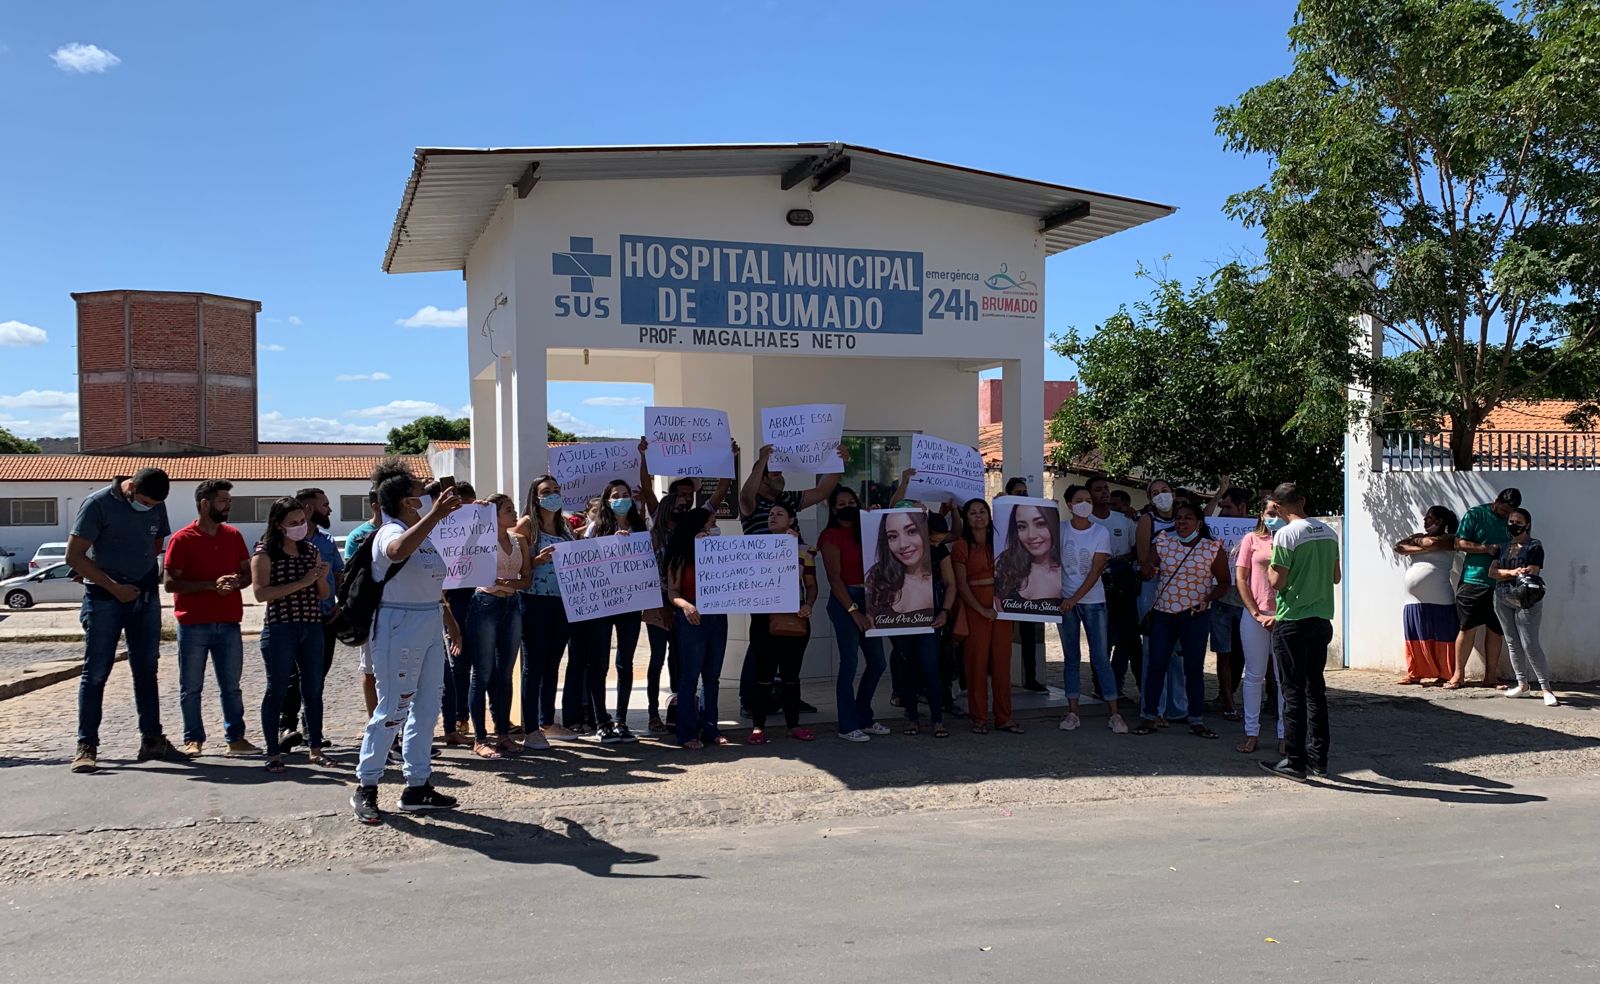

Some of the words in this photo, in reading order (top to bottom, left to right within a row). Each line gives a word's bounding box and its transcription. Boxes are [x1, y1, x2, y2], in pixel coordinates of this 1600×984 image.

[624, 241, 776, 285] HOSPITAL
[783, 251, 920, 291] MUNICIPAL
[925, 269, 979, 282] emergência
[554, 295, 610, 319] SUS
[658, 287, 697, 324] DE
[727, 290, 883, 330] BRUMADO
[927, 287, 979, 321] 24h
[982, 296, 1038, 313] BRUMADO
[639, 327, 683, 344] PROF.
[692, 329, 800, 348] MAGALHAES
[812, 333, 856, 350] NETO
[653, 415, 711, 427] AJUDE-NOS
[716, 418, 724, 427] A
[768, 414, 806, 429] ABRACE
[810, 412, 833, 424] ESSA
[653, 430, 686, 443] SALVAR
[692, 431, 713, 442] ESSA
[556, 445, 629, 466] AJUDE-NOS
[917, 451, 944, 461] SALVAR
[946, 455, 963, 466] ESSA
[965, 450, 972, 458] A
[566, 460, 607, 478] SALVAR
[613, 458, 639, 472] ESSA
[472, 509, 481, 520] A
[440, 526, 466, 539] ESSA
[469, 522, 496, 535] VIDA
[702, 538, 767, 553] PRECISAMOS
[774, 538, 789, 549] DE
[562, 549, 602, 567] ACORDA
[698, 555, 714, 565] UM
[559, 566, 605, 585] ESTAMOS
[697, 566, 756, 582] PRECISAMOS
[760, 566, 772, 575] DE
[777, 564, 797, 574] UMA
[565, 582, 587, 594] UMA
[590, 577, 611, 589] VIDA
[589, 591, 600, 602] OS
[1002, 599, 1022, 609] Todos
[1022, 600, 1038, 611] Por
[575, 604, 600, 616] NESSA
[875, 614, 895, 625] Todos
[895, 614, 911, 624] Por
[911, 613, 934, 624] Silene
